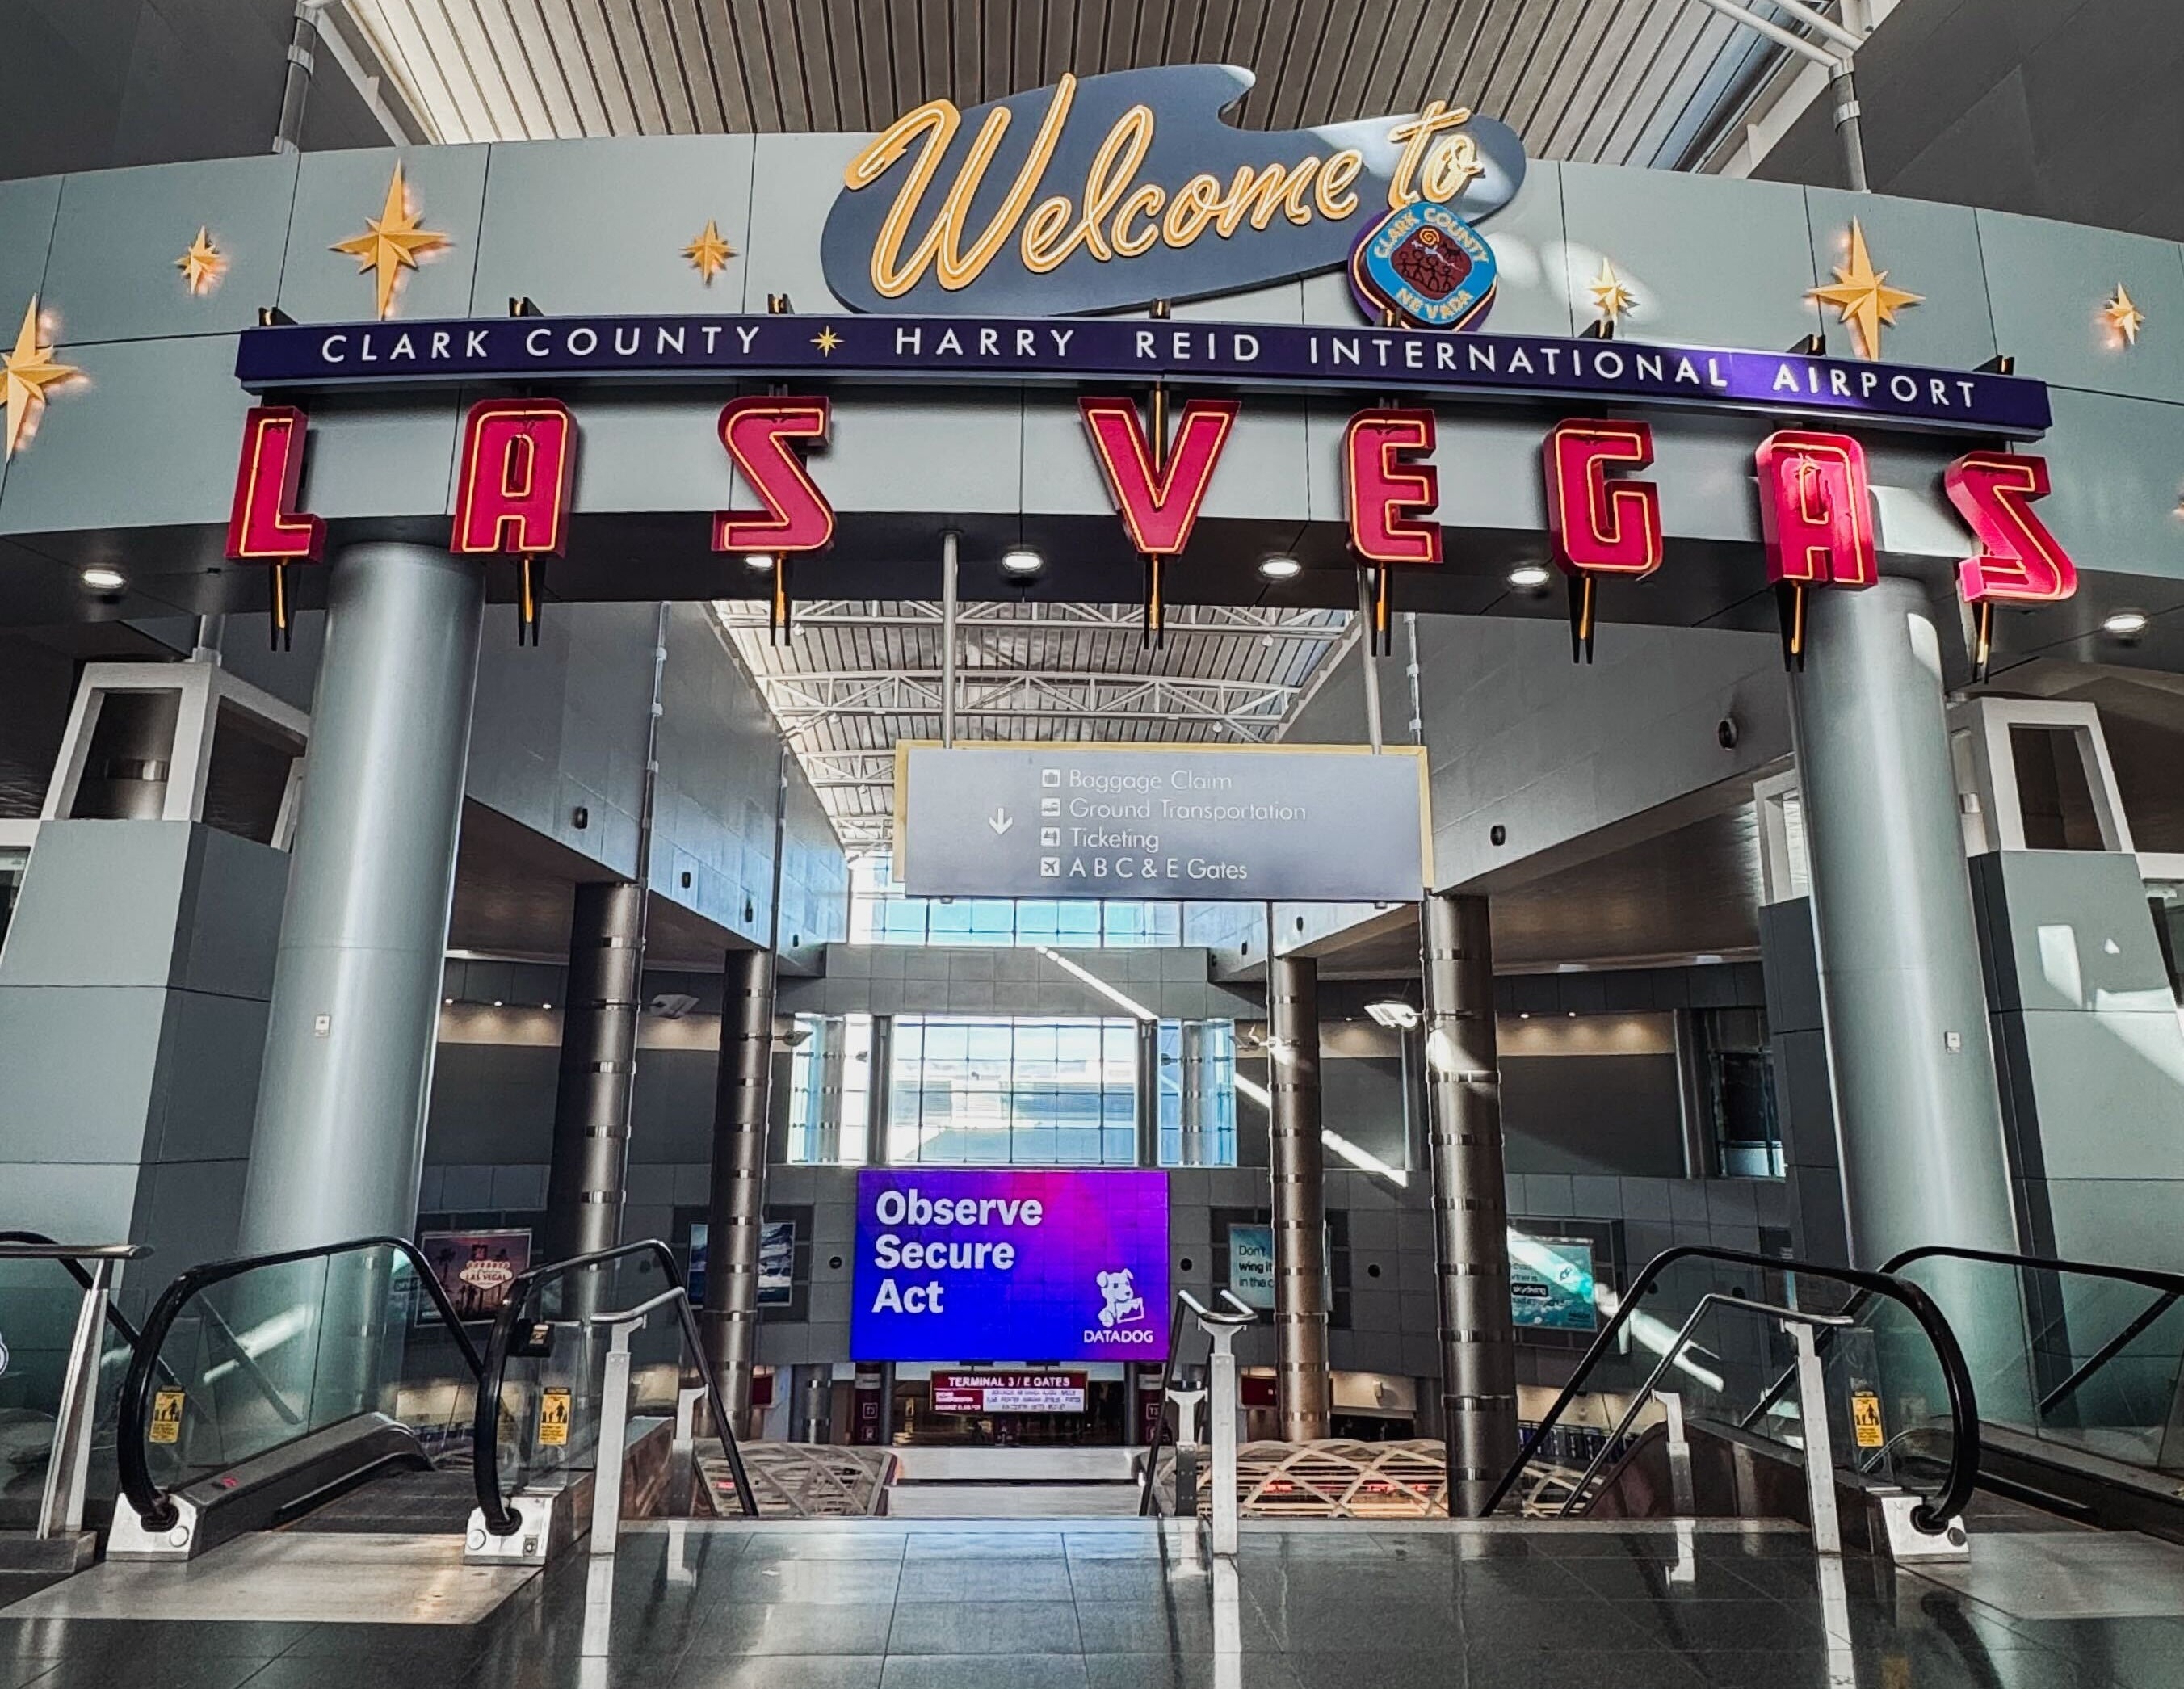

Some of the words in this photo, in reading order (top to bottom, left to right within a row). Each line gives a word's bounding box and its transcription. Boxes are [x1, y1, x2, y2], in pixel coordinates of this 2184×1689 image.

[844, 72, 1364, 298] Welcome
[1389, 100, 1486, 208] to
[1375, 210, 1419, 259] CLARK
[1424, 208, 1489, 263] COUNTY
[1396, 288, 1472, 319] NEVADA
[321, 329, 489, 362] CLARK
[526, 326, 760, 357] COUNTY
[896, 326, 1075, 357] HARRY
[1136, 330, 1261, 362] REID
[1309, 337, 1728, 388] INTERNATIONAL
[1772, 347, 1976, 409] AIRPORT
[226, 396, 835, 561] LAS
[1077, 397, 2078, 603] VEGAS
[1069, 769, 1162, 794] Baggage
[1170, 770, 1233, 791] Claim
[1069, 796, 1151, 819] Ground
[1160, 798, 1307, 822] Transportation
[1069, 826, 1160, 853] Ticketing
[1069, 857, 1086, 878] A
[1094, 857, 1107, 878] B
[1115, 857, 1134, 879] C
[1140, 858, 1158, 879] &
[1166, 858, 1179, 879] E
[1187, 858, 1248, 880] Gates
[876, 1188, 1043, 1226] Observe
[874, 1233, 1016, 1271] Secure
[872, 1278, 944, 1314] Act
[1084, 1330, 1154, 1344] DATADOG
[948, 1376, 1005, 1387] TERMINAL
[1008, 1376, 1014, 1387] 3
[1023, 1376, 1031, 1387] E
[1034, 1376, 1070, 1387] GATES
